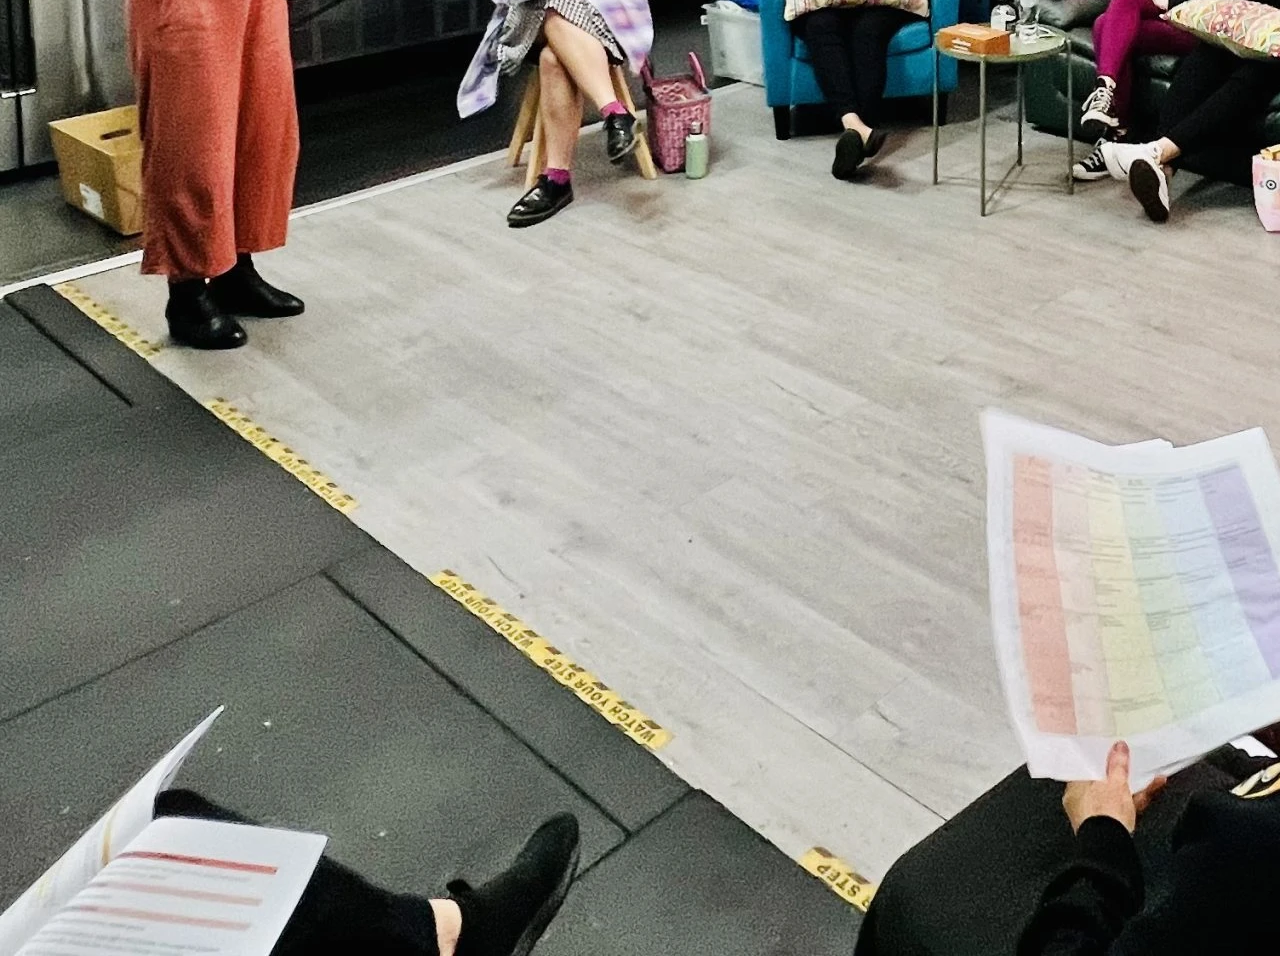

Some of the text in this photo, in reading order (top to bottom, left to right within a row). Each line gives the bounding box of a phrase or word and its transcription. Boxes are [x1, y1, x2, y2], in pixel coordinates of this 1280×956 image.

[440, 579, 533, 649] WATCH YOUR STEP
[544, 658, 656, 742] WATCH YOUR STEP
[816, 865, 861, 897] STEP
